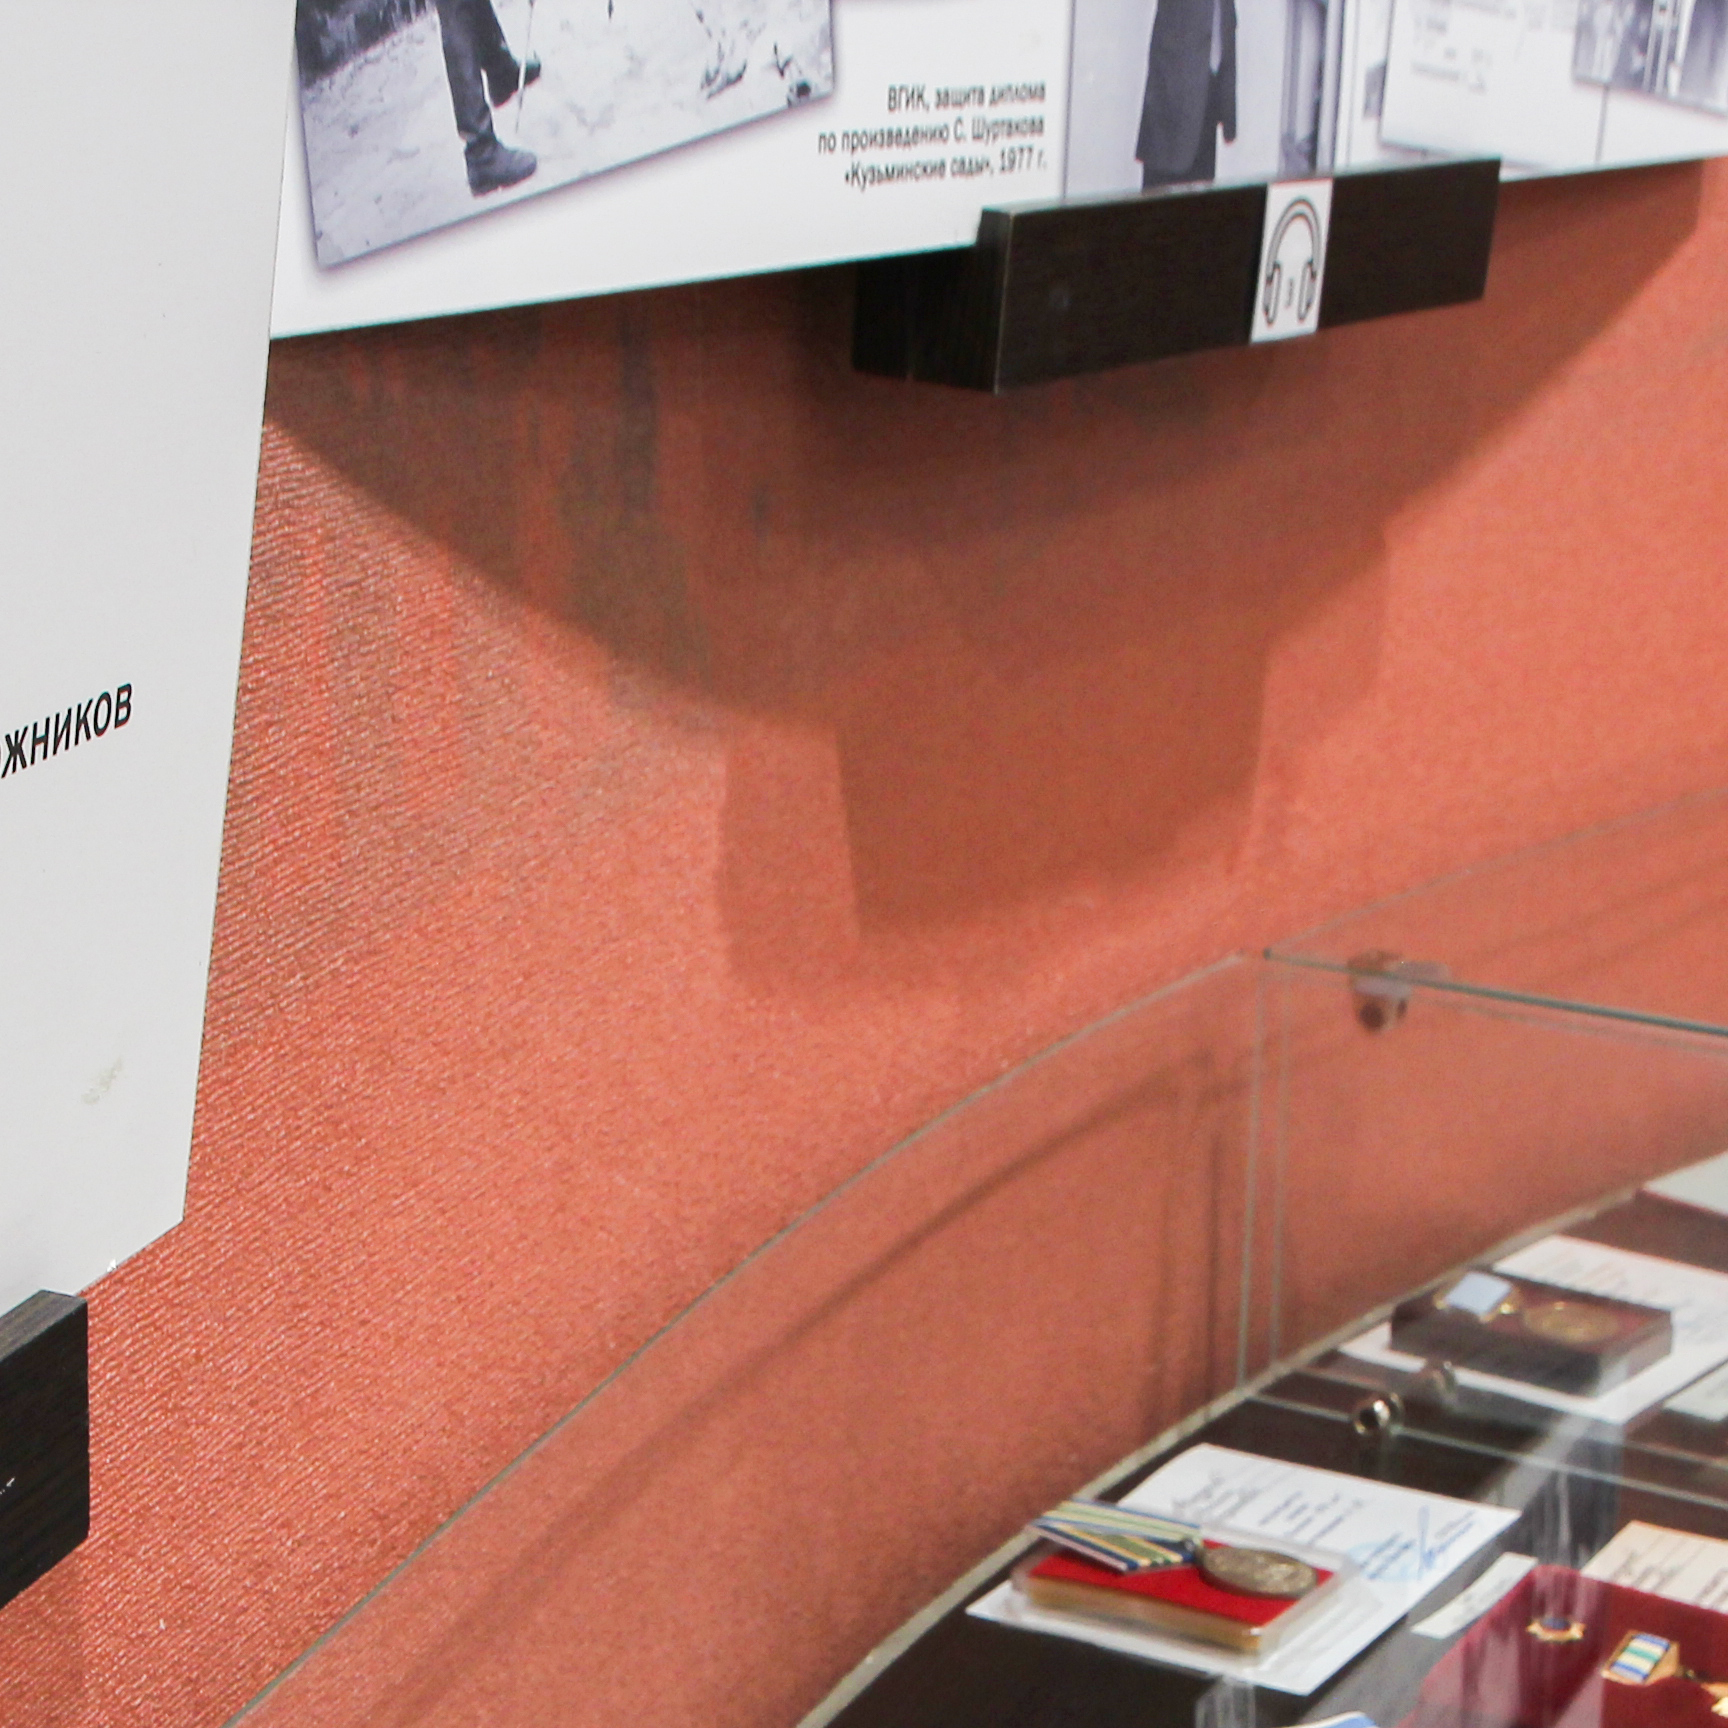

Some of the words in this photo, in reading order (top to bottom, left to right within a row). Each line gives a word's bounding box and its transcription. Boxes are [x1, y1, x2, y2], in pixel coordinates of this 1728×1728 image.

[888, 84, 930, 112] ВГИК,
[935, 85, 985, 109] защита
[989, 81, 1046, 105] диплома
[818, 132, 836, 153] по
[842, 124, 949, 155] произведению
[954, 117, 966, 141] С.
[972, 115, 1044, 145] Шуртакова
[999, 146, 1034, 172] 1977
